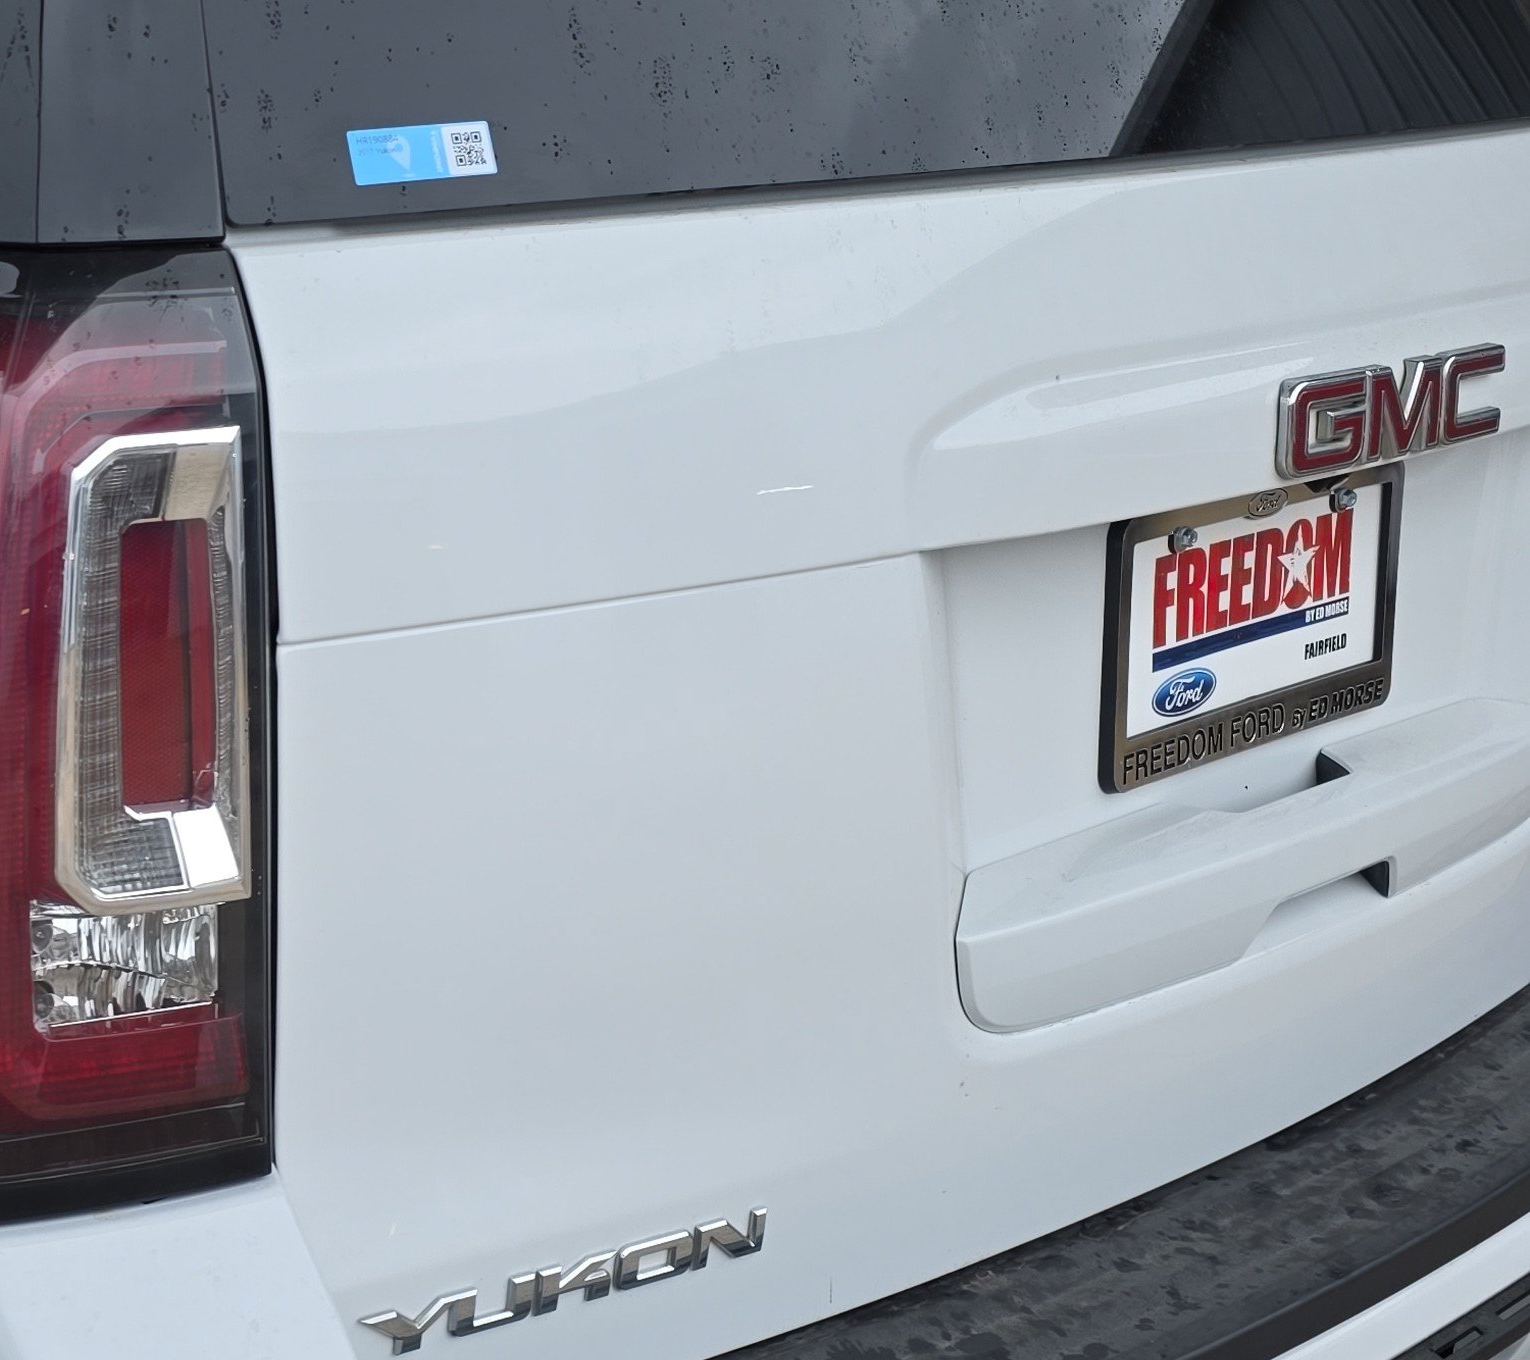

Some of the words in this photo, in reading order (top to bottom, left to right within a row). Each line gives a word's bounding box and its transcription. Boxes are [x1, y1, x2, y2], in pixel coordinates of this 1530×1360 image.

[1274, 342, 1506, 480] GMC
[1255, 491, 1281, 512] Ford
[1152, 508, 1354, 650] FREEDOM
[1305, 609, 1316, 623] BY
[1315, 606, 1325, 621] ED
[1325, 598, 1348, 618] MORSE
[1304, 633, 1347, 660] FAIRFIELD
[1165, 675, 1203, 710] Ford
[1123, 722, 1223, 785] FREEDOM
[1230, 703, 1286, 747] FORD
[1308, 696, 1329, 721] ED
[1329, 678, 1385, 716] MORSE
[358, 1207, 768, 1356] YUKON
